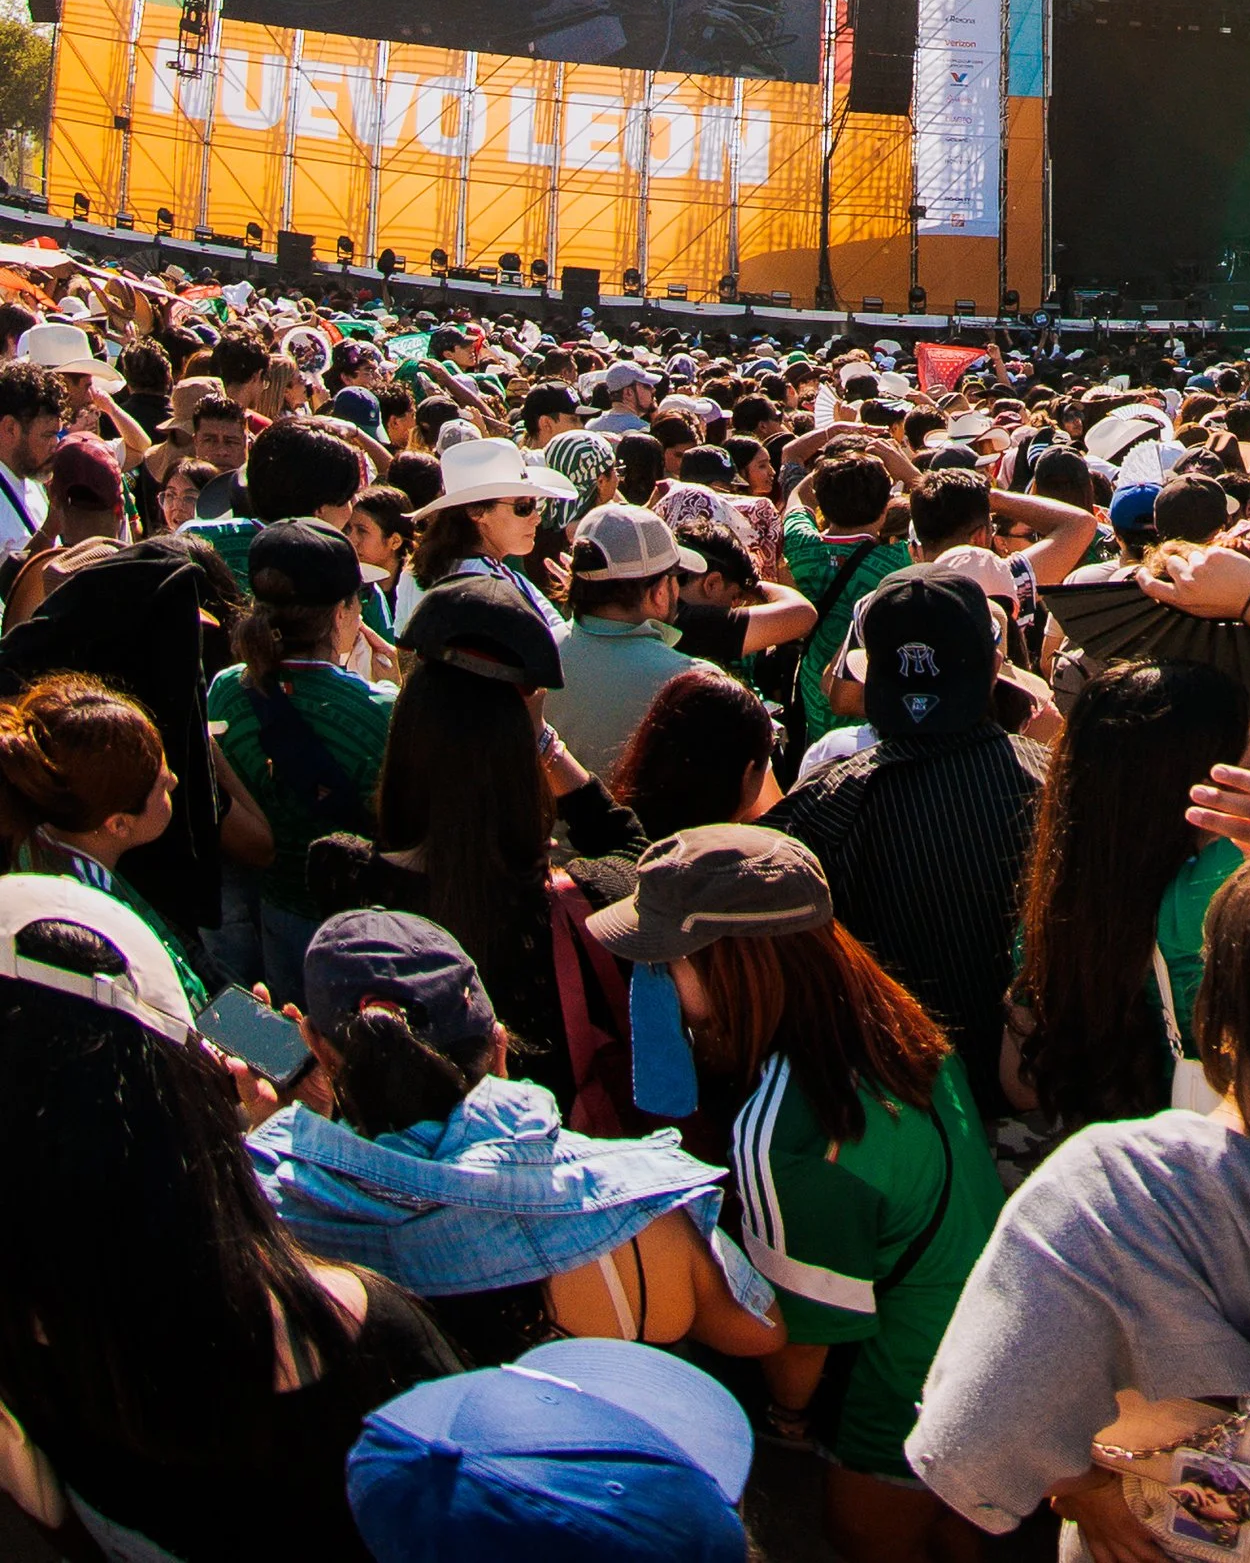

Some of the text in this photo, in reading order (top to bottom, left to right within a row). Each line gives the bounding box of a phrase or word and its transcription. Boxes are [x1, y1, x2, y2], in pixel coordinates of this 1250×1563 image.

[945, 38, 977, 48] verizon
[150, 37, 771, 186] NUEVO LEÓN
